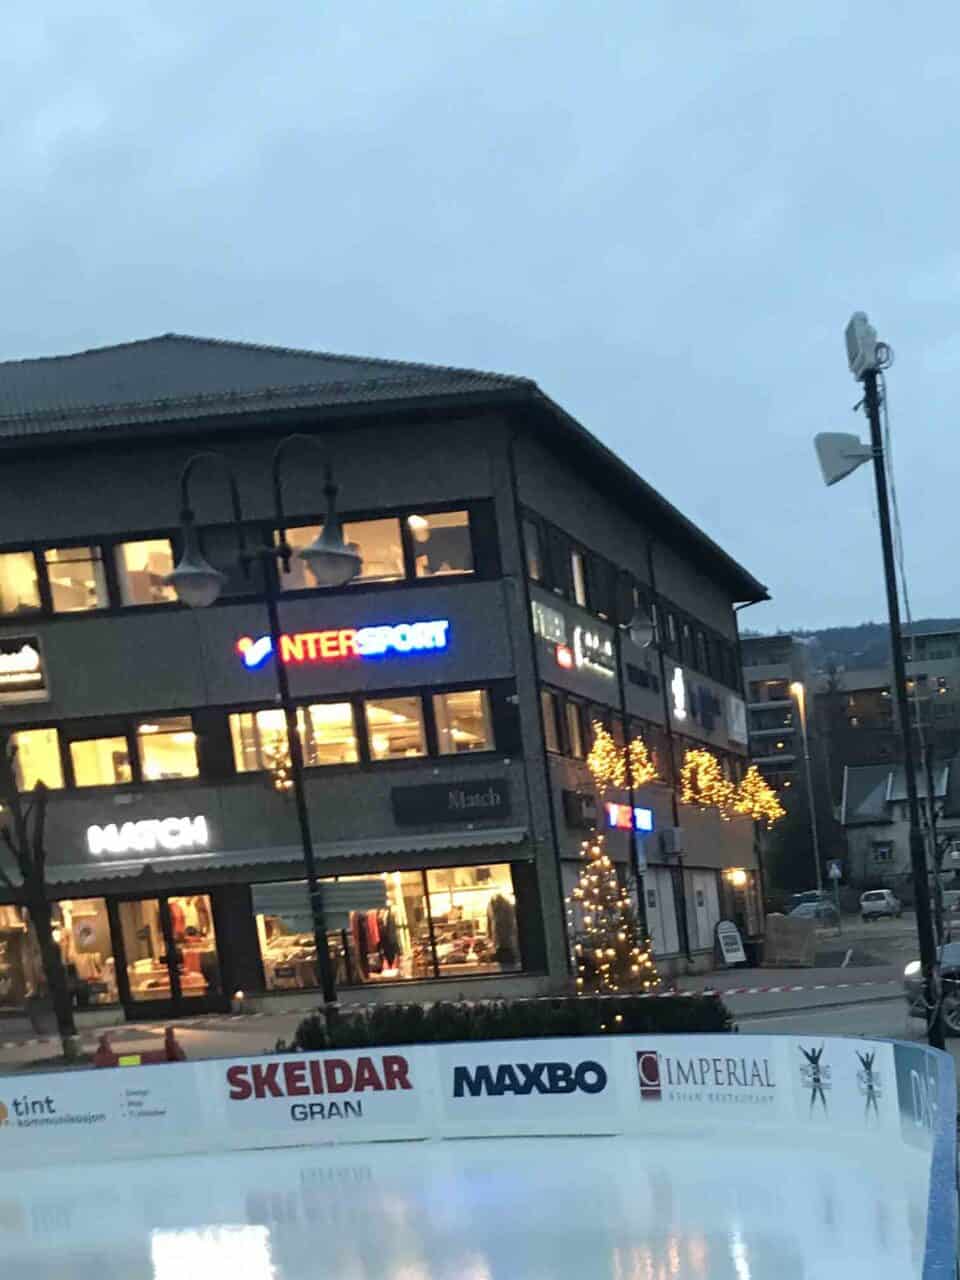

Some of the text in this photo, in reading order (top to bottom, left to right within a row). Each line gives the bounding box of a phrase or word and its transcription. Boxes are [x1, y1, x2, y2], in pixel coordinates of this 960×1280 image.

[270, 620, 449, 663] NTERSPORT
[87, 815, 209, 855] MATCH
[226, 1055, 413, 1101] SKEIDAR
[453, 1060, 608, 1098] MAXBO
[664, 1057, 777, 1088] IMPERIAL
[12, 1095, 56, 1117] tint
[290, 1100, 363, 1121] GRAN
